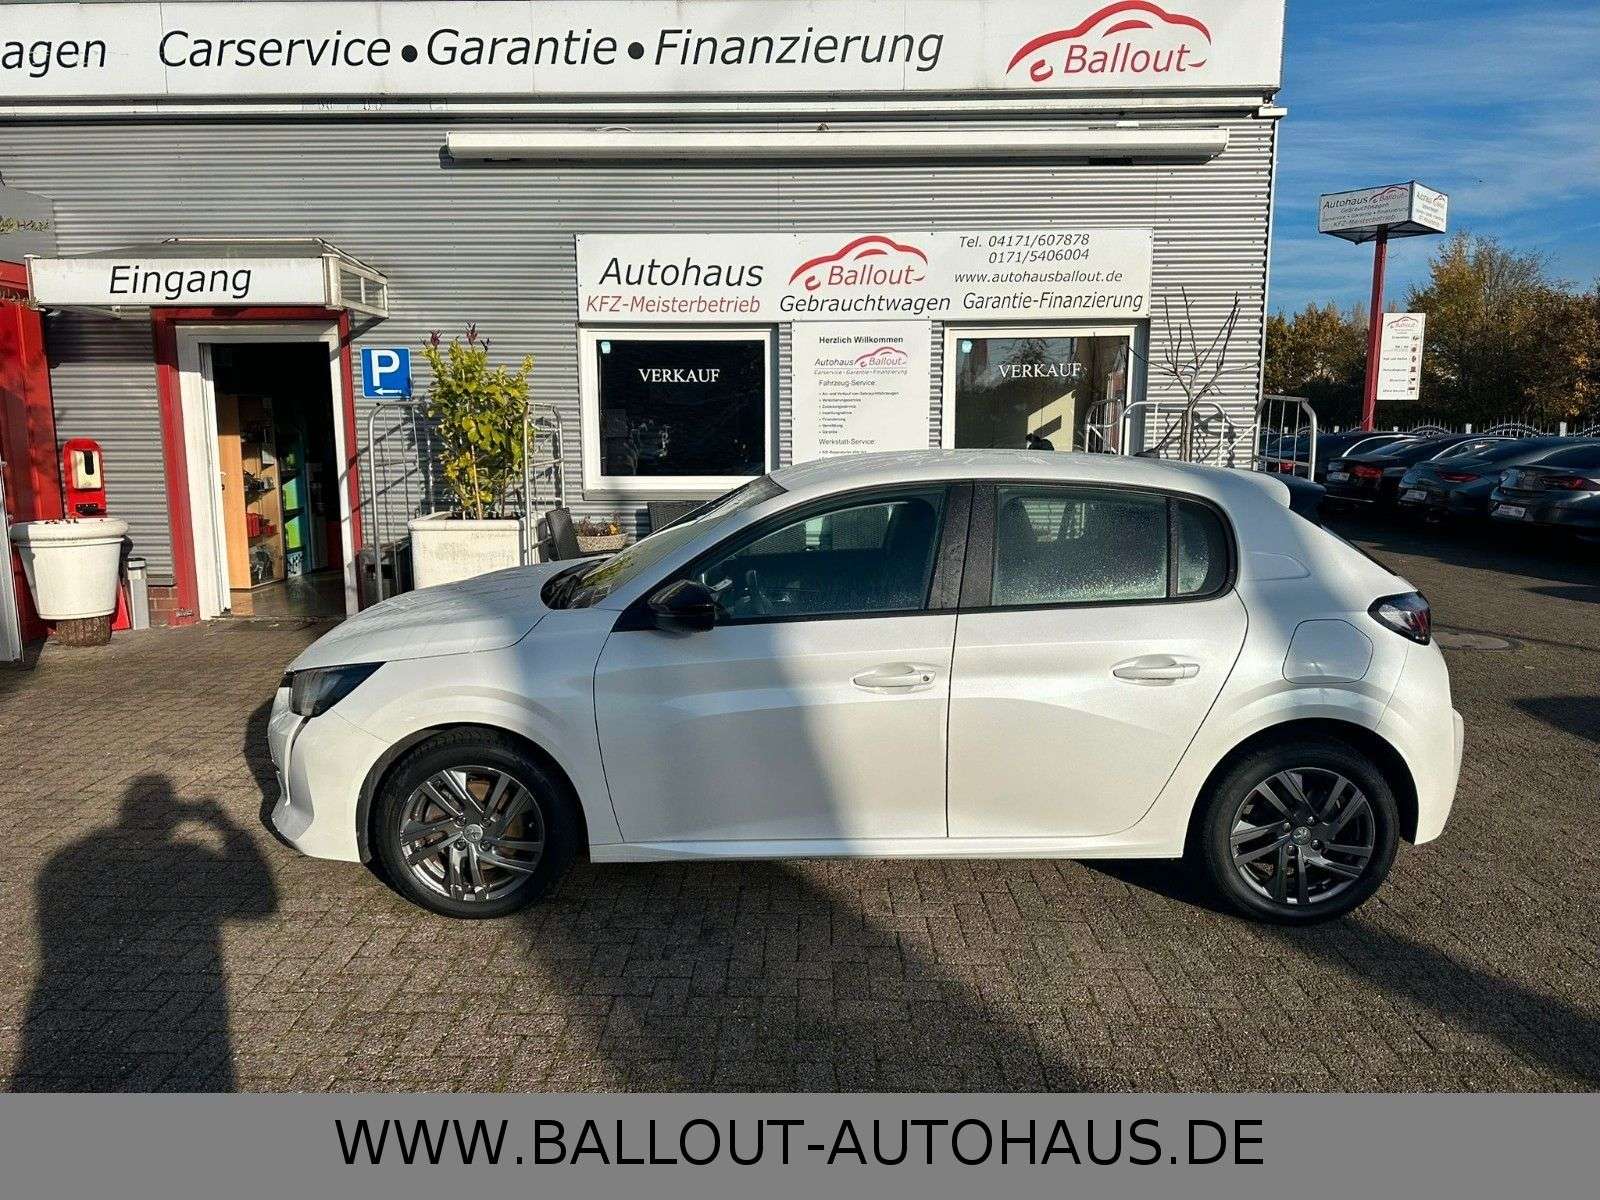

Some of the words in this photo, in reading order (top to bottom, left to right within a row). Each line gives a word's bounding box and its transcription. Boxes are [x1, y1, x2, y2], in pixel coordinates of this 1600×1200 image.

[159, 30, 391, 67] Carservice
[427, 28, 617, 66] Garantie
[654, 27, 944, 72] Finanzierung
[1063, 42, 1191, 74] Ballout
[1322, 198, 1368, 209] Autohaus
[960, 236, 982, 248] Tel.
[988, 233, 1090, 248] 04171/607878
[988, 248, 1090, 264] 0171/5406004
[599, 257, 764, 287] Autohaus
[827, 264, 914, 286] Ballout
[954, 270, 1123, 283] www.autohausballout.de
[109, 265, 252, 299] Eingang
[586, 295, 761, 313] KFZ-Meisterbetrieb
[779, 294, 951, 315] Gebrauchtwagen
[963, 291, 1144, 312] Garantie-Finanzierung
[819, 336, 852, 344] Herzlich
[853, 336, 904, 344] Willkommen
[370, 350, 400, 387] P
[814, 358, 854, 366] Autohaus
[868, 357, 902, 366] Ballout
[998, 362, 1082, 379] VERKAUF
[638, 367, 721, 384] VERKAUF
